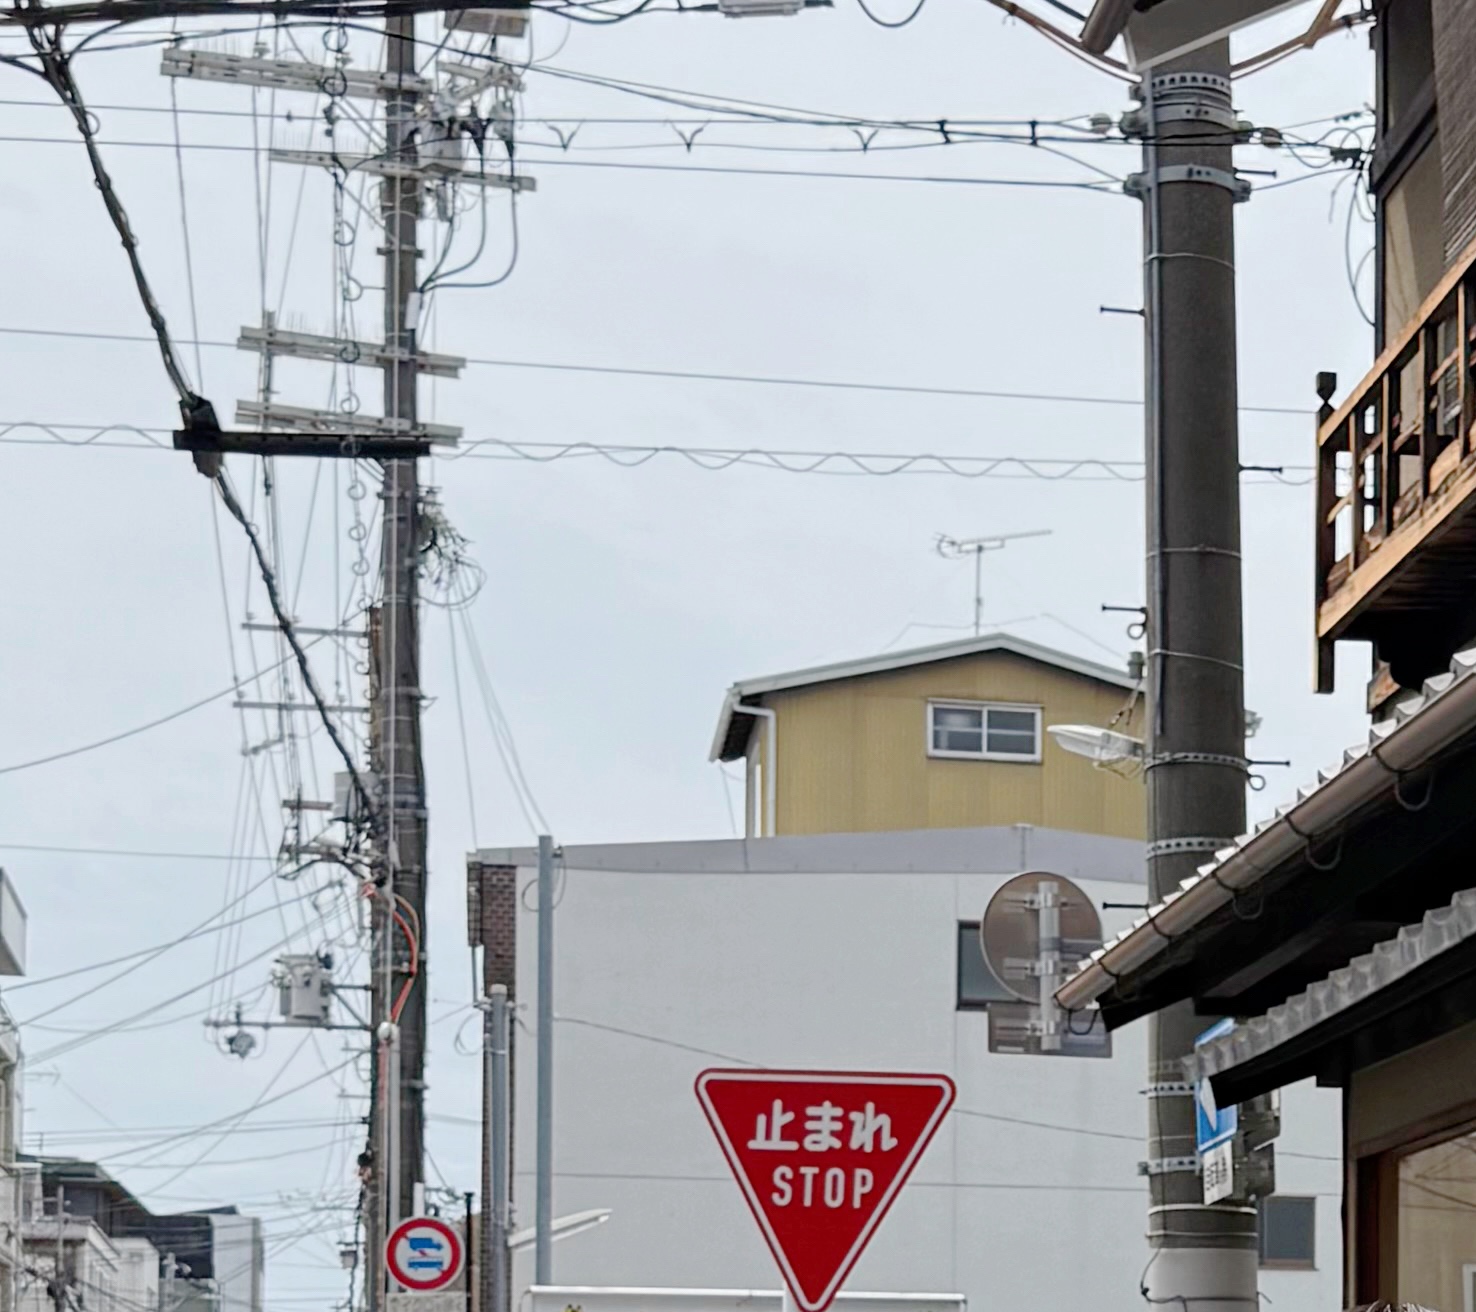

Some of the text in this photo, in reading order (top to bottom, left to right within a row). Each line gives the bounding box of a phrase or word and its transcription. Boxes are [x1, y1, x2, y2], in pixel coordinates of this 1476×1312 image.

[747, 1099, 898, 1153] 止まれ
[772, 1166, 874, 1209] STOP
